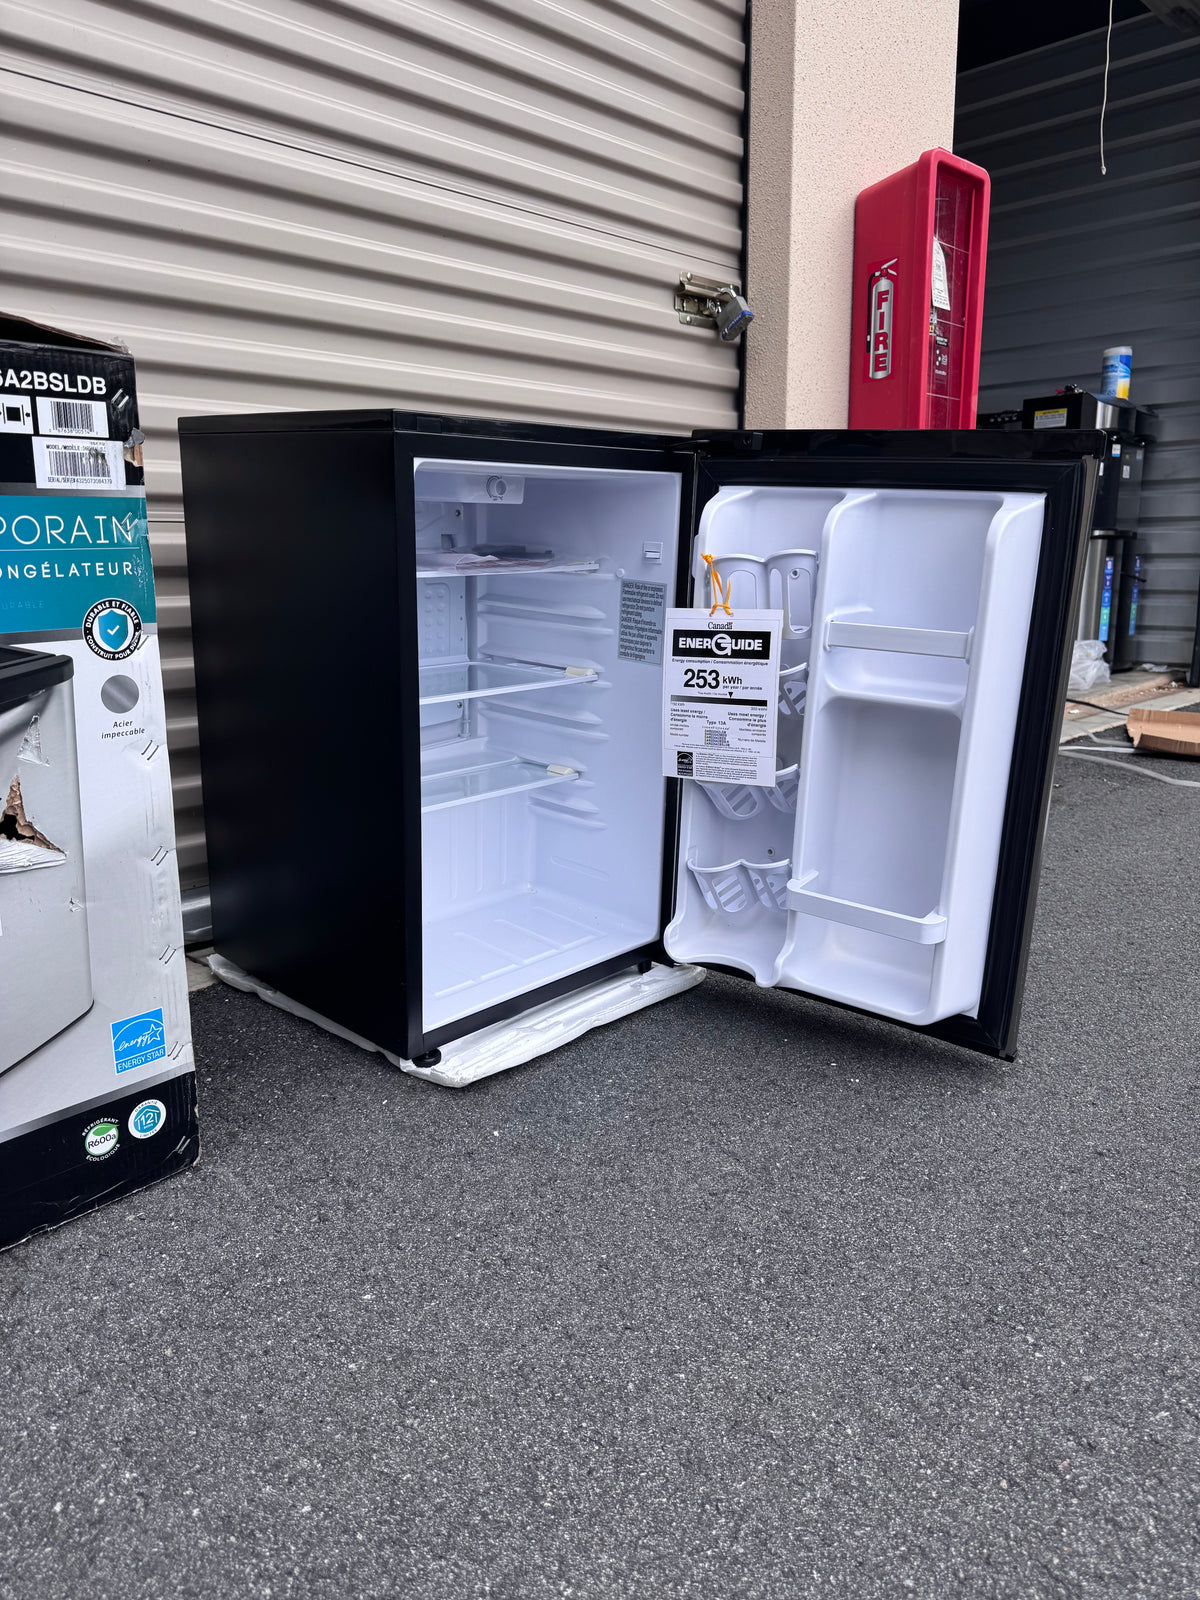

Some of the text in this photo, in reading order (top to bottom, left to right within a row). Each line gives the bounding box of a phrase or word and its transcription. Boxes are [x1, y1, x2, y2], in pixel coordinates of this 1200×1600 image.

[873, 290, 889, 373] FIRE
[0, 368, 107, 395] A2BSLDB
[85, 600, 140, 628] DURABLE ET FIABLE
[707, 621, 733, 630] Canada
[86, 635, 114, 660] CONSTRUIT
[114, 648, 132, 660] POUR
[678, 632, 763, 657] ENERGUIDE
[683, 668, 742, 689] 253 kWh
[101, 728, 145, 739] impeccable
[113, 720, 133, 728] Acier
[117, 1048, 165, 1072] ENERGY STAR
[140, 1112, 154, 1126] 12
[87, 1133, 117, 1149] R600a
